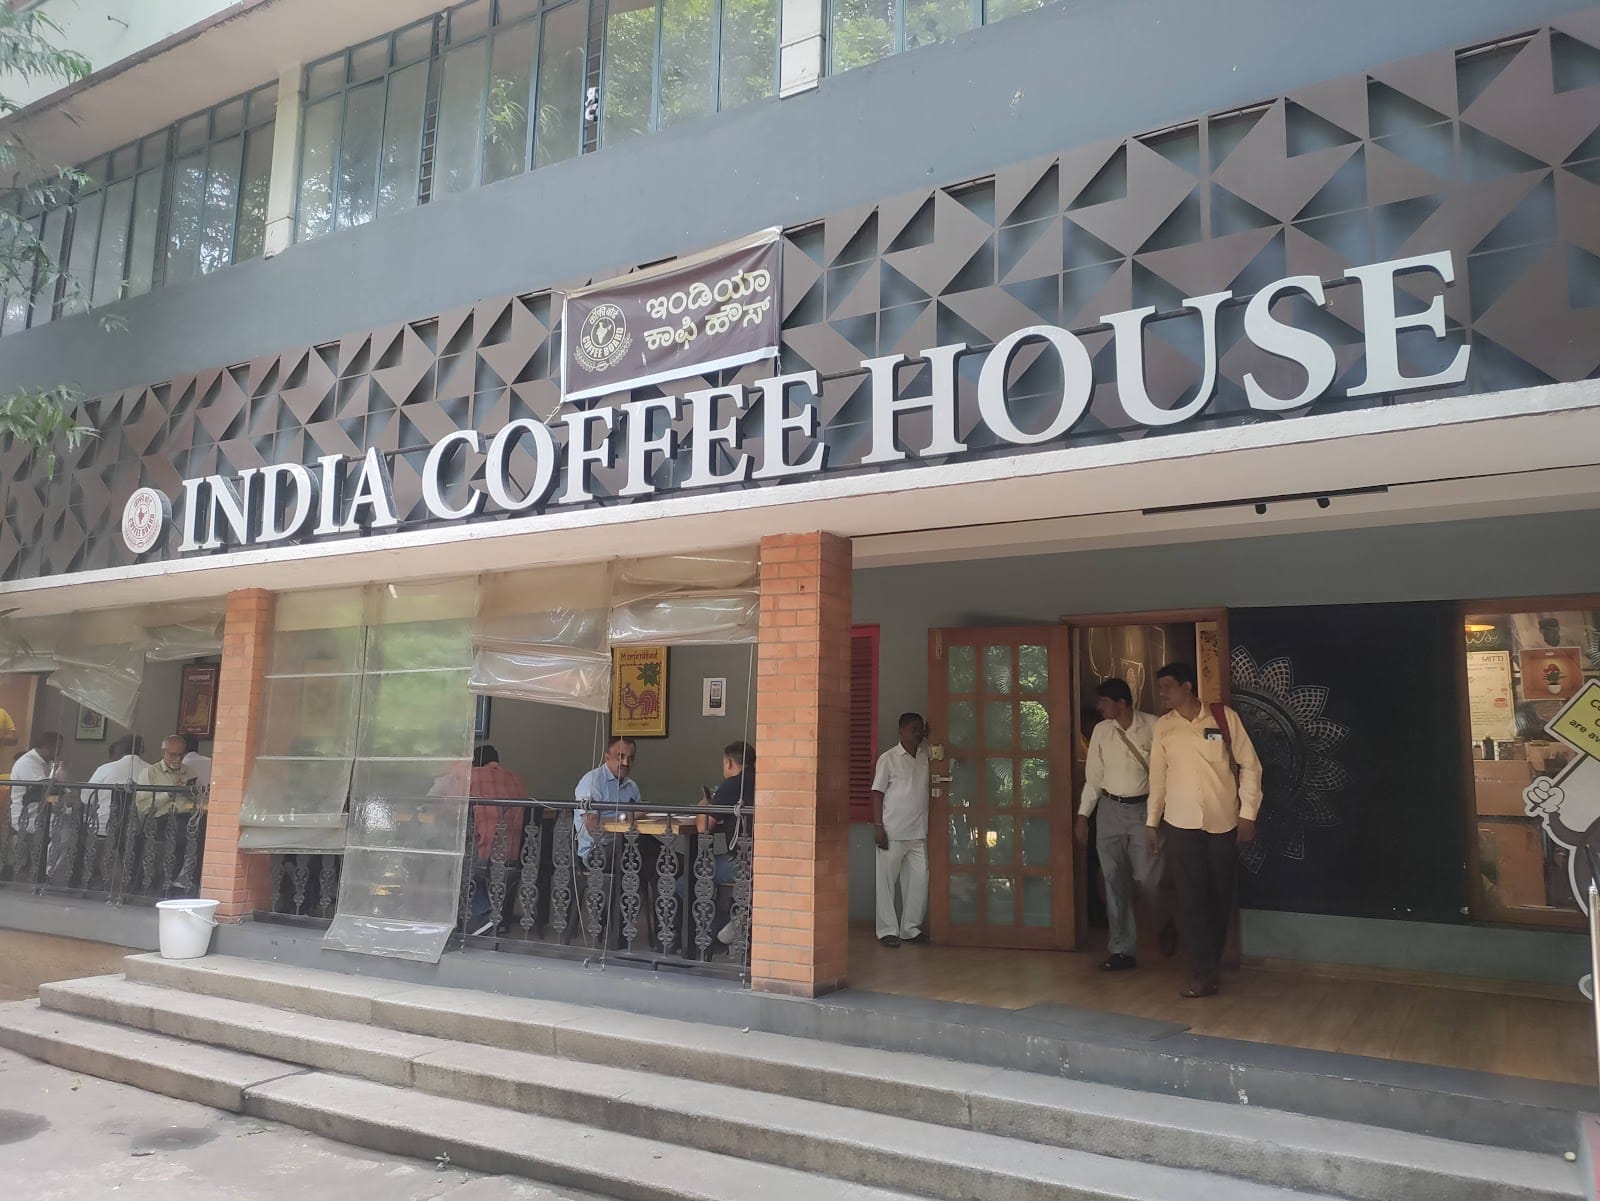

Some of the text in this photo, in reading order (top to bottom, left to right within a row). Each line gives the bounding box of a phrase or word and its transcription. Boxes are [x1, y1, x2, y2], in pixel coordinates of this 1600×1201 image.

[646, 268, 771, 320] ಇಂಡಿಯಾ
[583, 327, 625, 359] COFFEE BOARD
[643, 295, 771, 350] ಕಾಫಿ ಹೌಸ್
[178, 250, 1471, 552] INDIA COFFEE HOUSE
[1569, 719, 1587, 733] are
